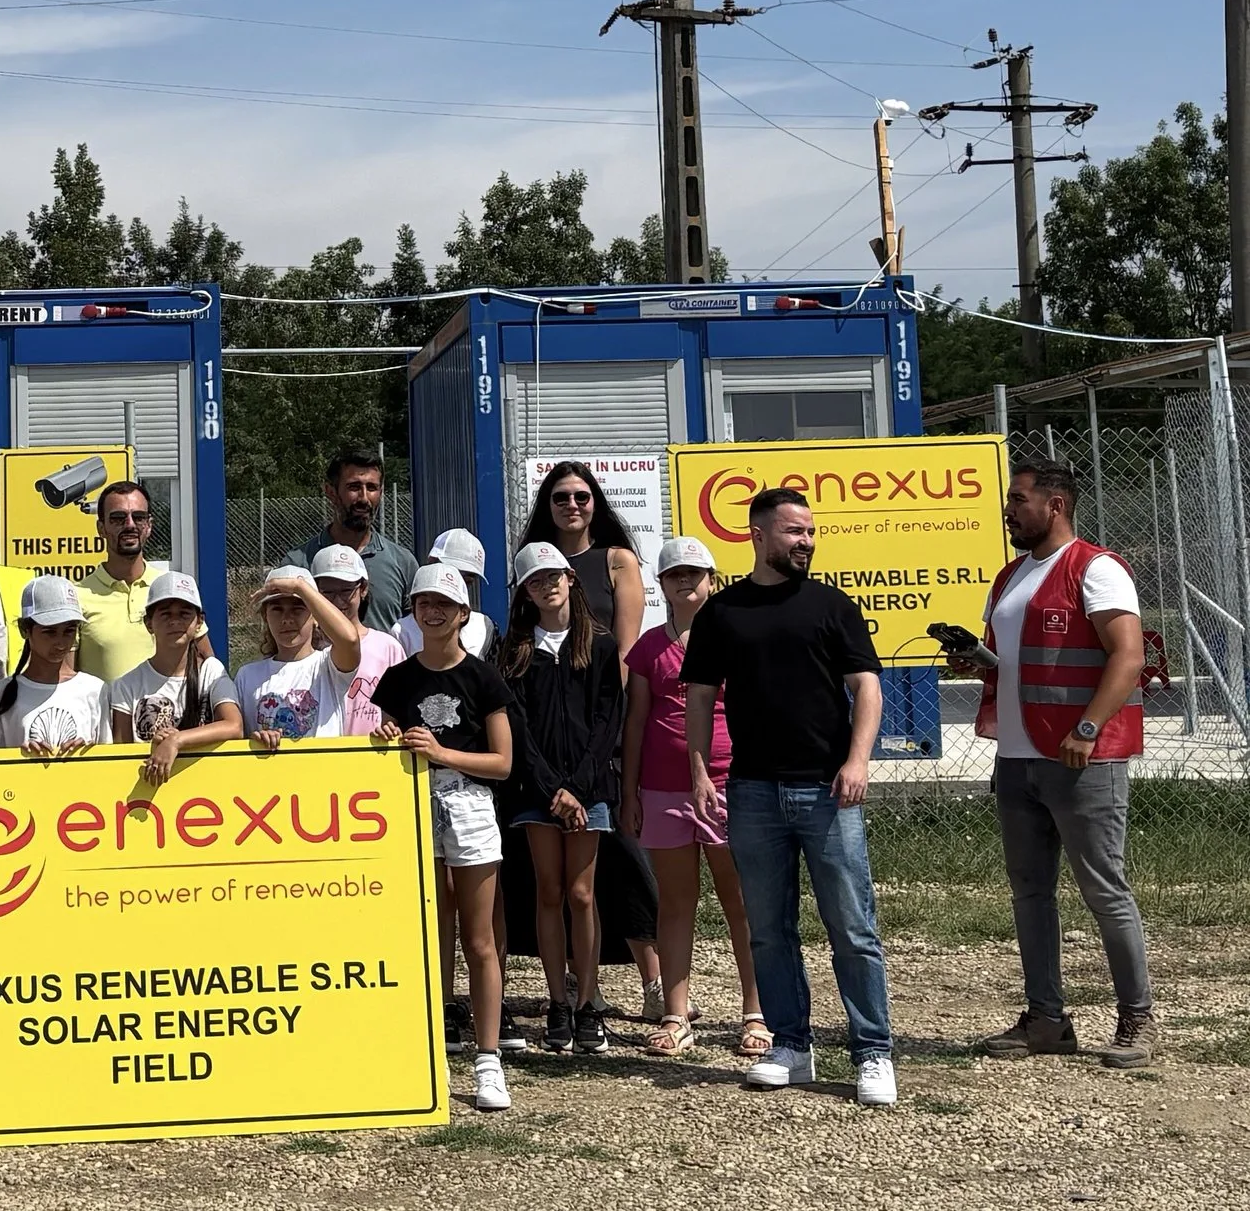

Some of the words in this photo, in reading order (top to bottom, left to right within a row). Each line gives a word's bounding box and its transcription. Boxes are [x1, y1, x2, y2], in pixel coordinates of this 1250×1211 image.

[477, 335, 492, 414] 1195
[896, 320, 912, 401] 1195
[204, 360, 220, 439] 1190
[596, 459, 609, 472] ÎN
[613, 460, 655, 472] LUCRU
[779, 467, 984, 503] enexus
[12, 538, 52, 555] THIS
[57, 537, 105, 554] FIELD
[819, 522, 869, 538] power
[875, 519, 890, 533] of
[894, 517, 981, 533] renewable
[810, 568, 929, 589] ENEWABLE
[936, 567, 990, 586] S.R.L
[848, 593, 932, 611] NERGY
[56, 791, 388, 853] enexus
[66, 884, 109, 908] the
[119, 885, 202, 913] power
[211, 878, 236, 902] of
[245, 874, 384, 901] renewable
[75, 963, 299, 1002] RENEWABLE
[310, 960, 399, 992] S.R.L
[18, 1013, 143, 1047] SOLAR
[154, 1006, 303, 1040] ENERGY
[111, 1051, 214, 1084] FIELD
